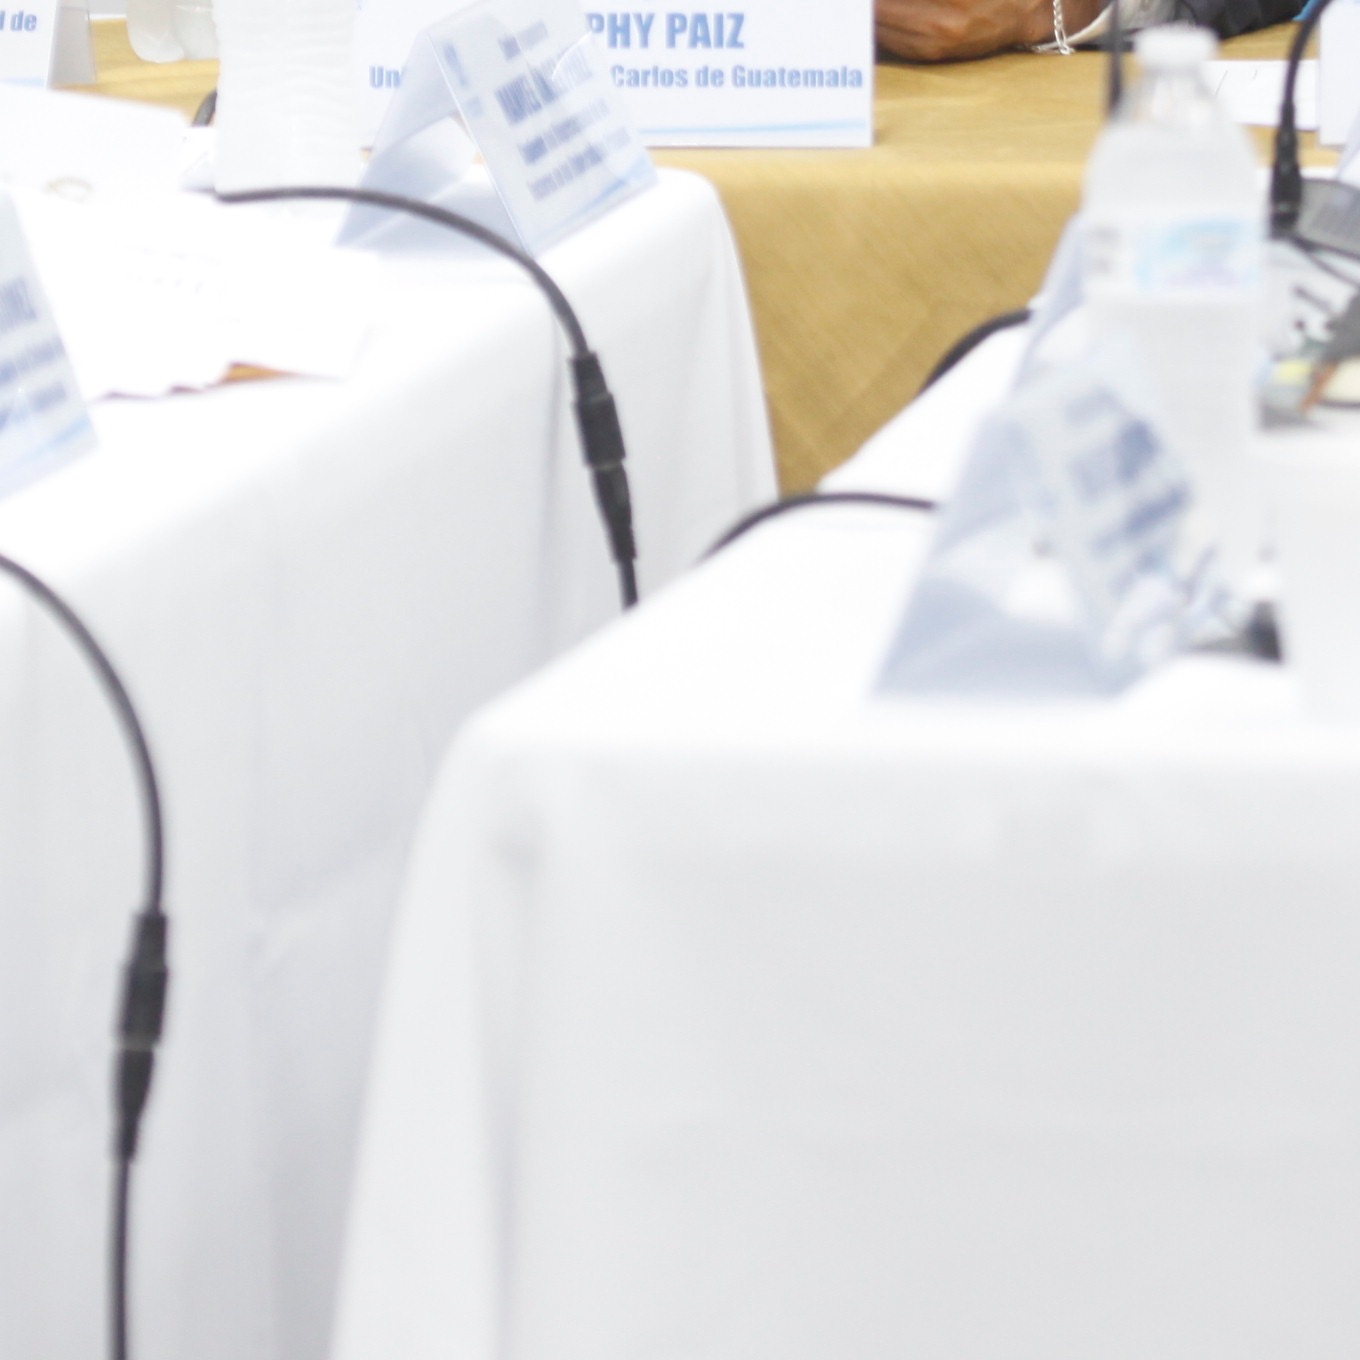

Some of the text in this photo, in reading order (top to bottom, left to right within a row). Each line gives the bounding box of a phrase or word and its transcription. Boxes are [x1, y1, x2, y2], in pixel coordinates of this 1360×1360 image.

[9, 10, 38, 32] de
[586, 13, 655, 49] PHY
[665, 13, 746, 49] PAIZ
[611, 64, 864, 88] Carlos de Guatemala
